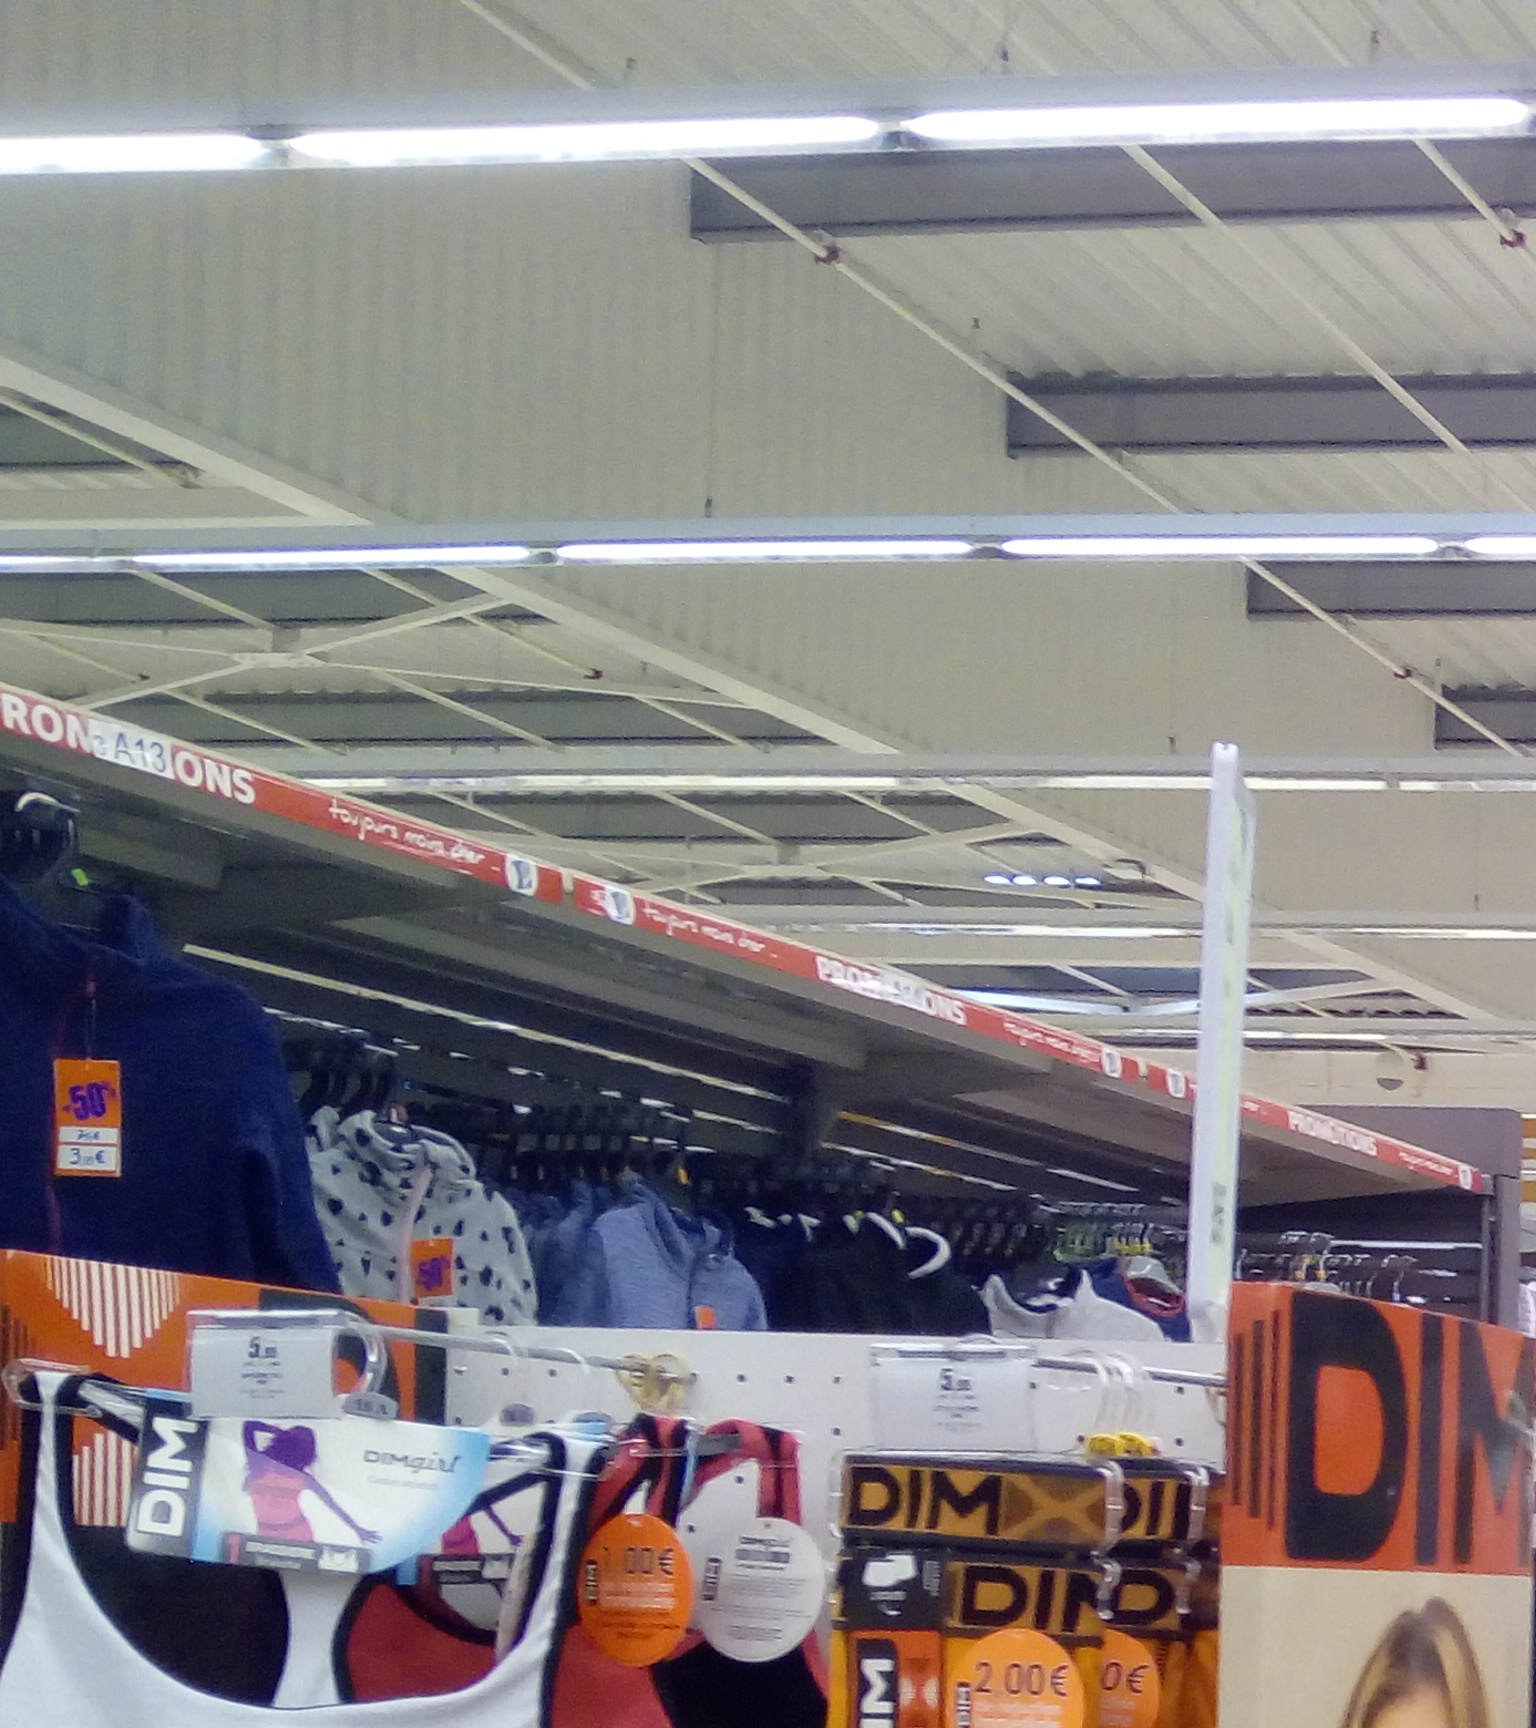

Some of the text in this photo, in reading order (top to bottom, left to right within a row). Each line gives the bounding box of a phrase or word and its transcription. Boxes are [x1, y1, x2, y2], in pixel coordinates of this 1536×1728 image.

[137, 1417, 198, 1537] DIM
[1285, 1292, 1533, 1565] DIM
[850, 1466, 1003, 1536] DIM
